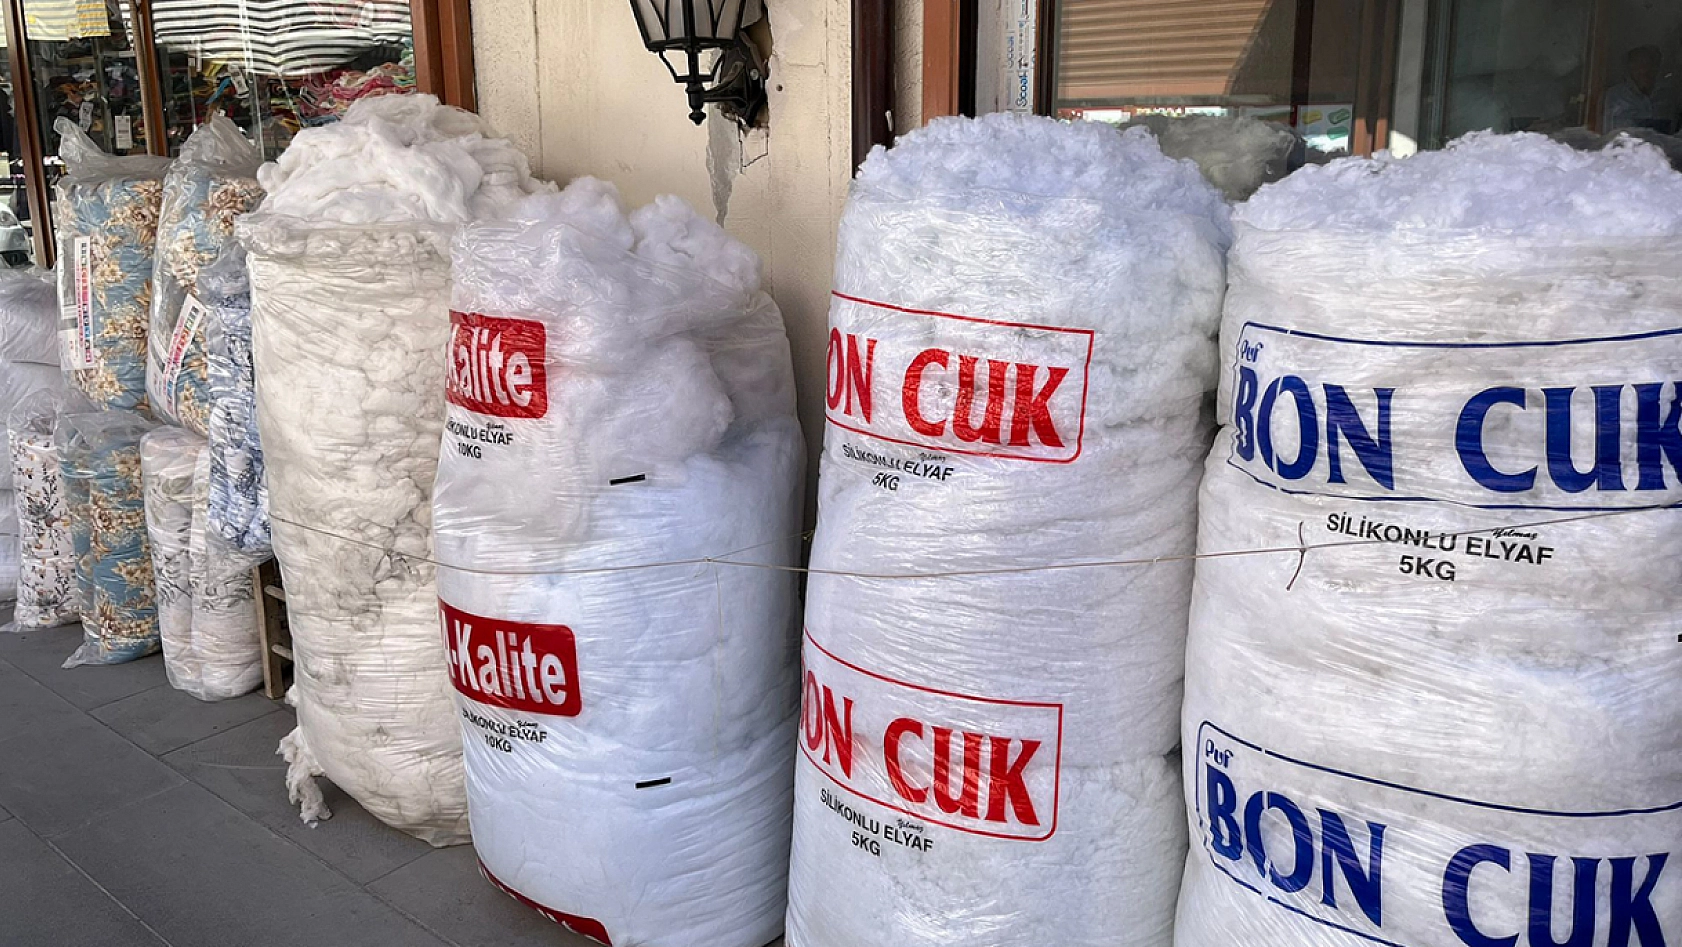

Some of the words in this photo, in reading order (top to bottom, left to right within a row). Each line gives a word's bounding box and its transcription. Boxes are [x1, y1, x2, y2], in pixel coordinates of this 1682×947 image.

[902, 348, 1070, 448] CUK
[480, 428, 514, 445] ELYAF
[1235, 365, 1396, 491] BON
[1455, 380, 1682, 493] CUK
[458, 442, 482, 459] 10KG
[872, 472, 900, 491] 5KG
[903, 460, 954, 481] ELYAF
[1326, 511, 1458, 552] SİLİKONLU
[1465, 536, 1554, 565] ELYAF
[1399, 555, 1456, 582] 5KG
[485, 733, 512, 753] 10KG
[508, 725, 548, 743] ELYAF
[1205, 739, 1234, 769] Puf
[884, 717, 1041, 826] CUK
[820, 787, 880, 835] SİLİKONLU
[883, 824, 934, 852] ELYAF
[851, 830, 880, 857] 5KG
[1205, 762, 1387, 928] BON
[1442, 843, 1671, 947] CUK
